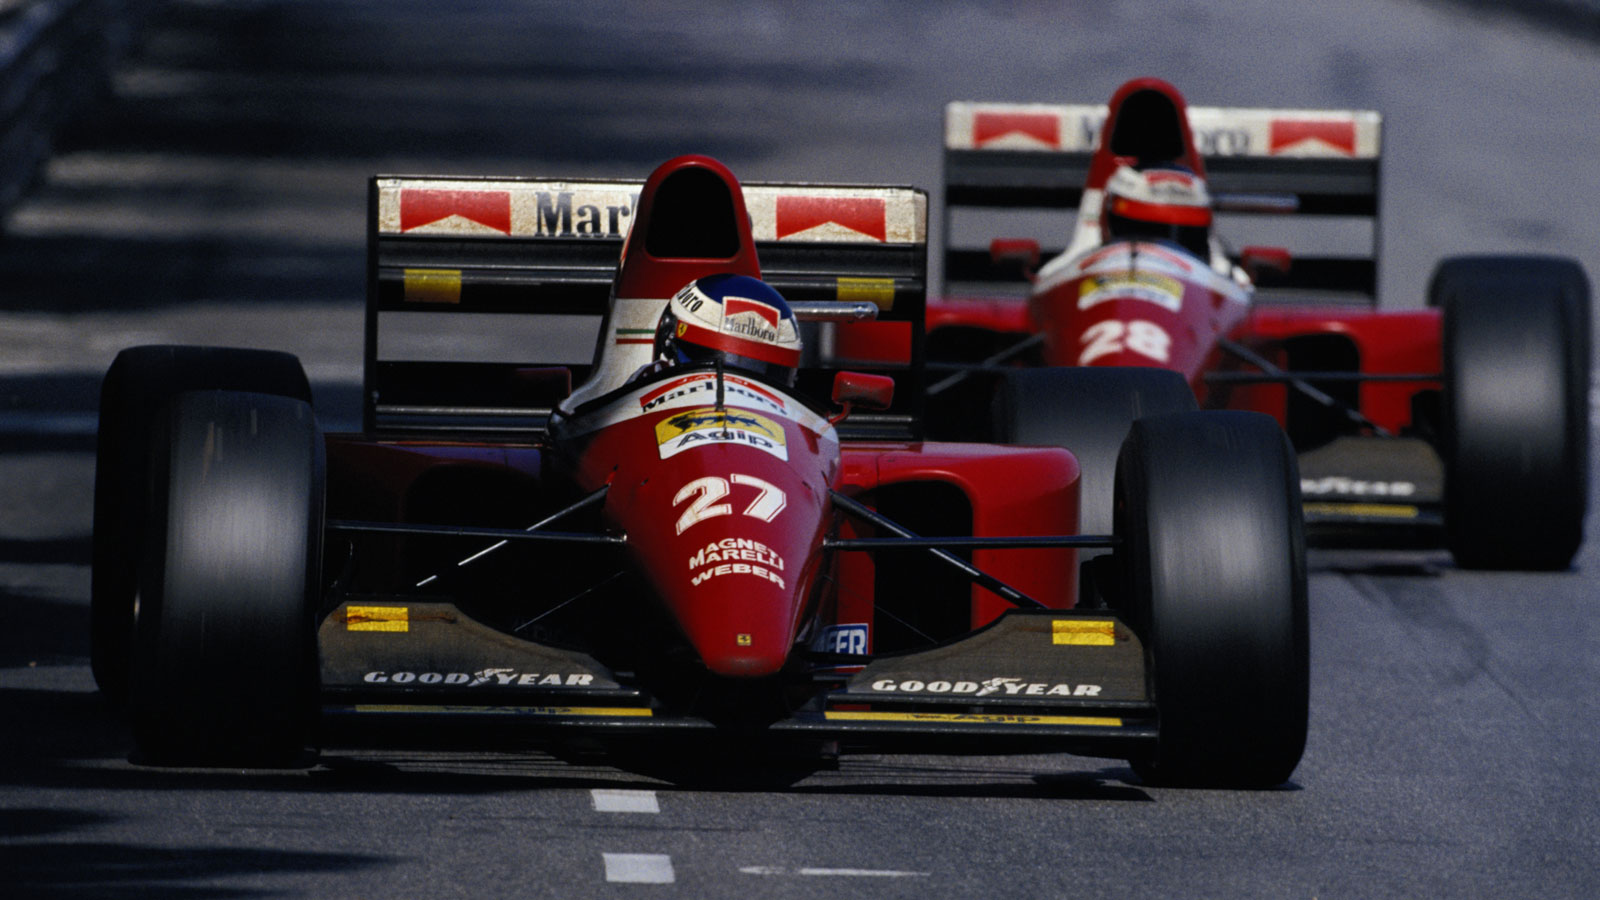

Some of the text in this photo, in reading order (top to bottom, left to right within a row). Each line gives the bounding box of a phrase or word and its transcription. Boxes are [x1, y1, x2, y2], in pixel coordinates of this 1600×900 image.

[723, 316, 775, 342] Marlboro
[1079, 318, 1171, 366] 28
[676, 430, 774, 449] Agip
[672, 473, 787, 536] 27
[691, 563, 785, 590] WEBER
